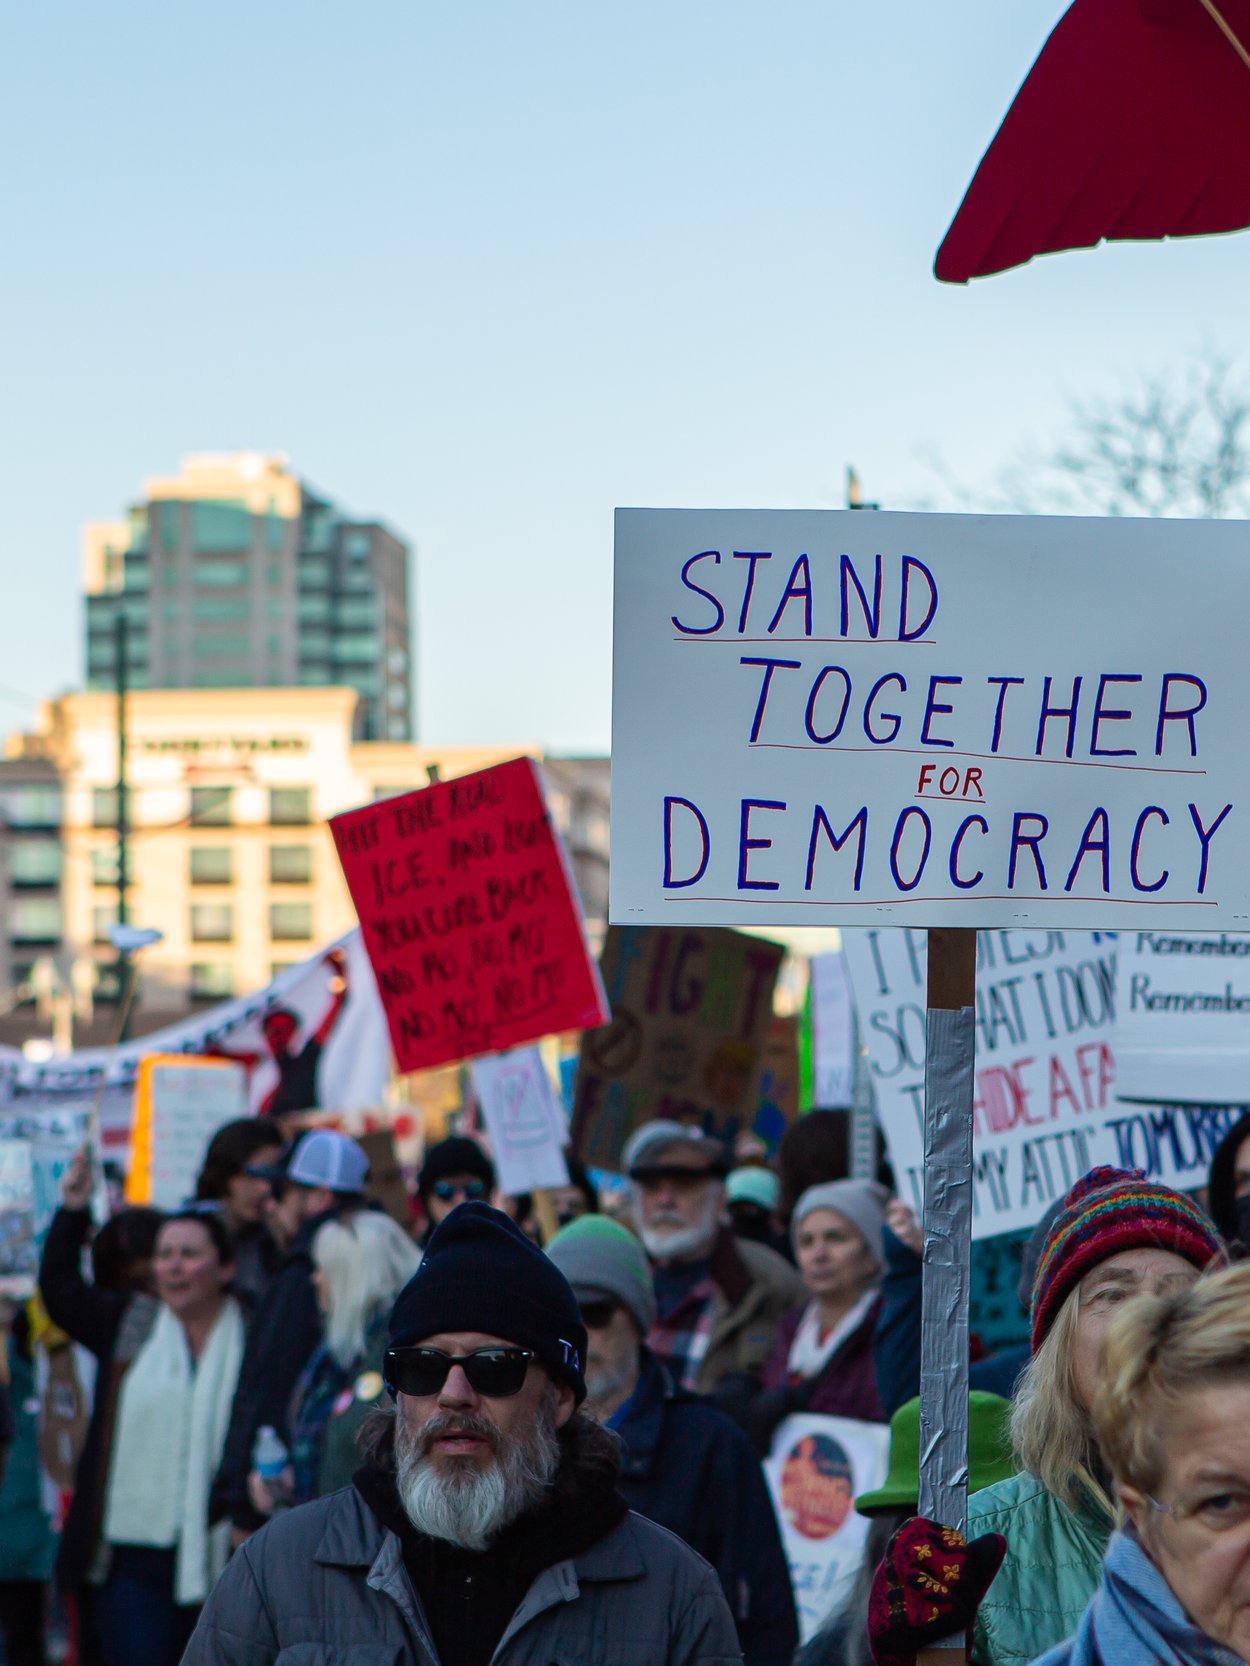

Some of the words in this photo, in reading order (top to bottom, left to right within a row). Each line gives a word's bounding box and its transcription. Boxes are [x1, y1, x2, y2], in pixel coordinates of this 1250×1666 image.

[670, 550, 939, 641] STAND
[739, 656, 1208, 760] TOGETHER
[917, 763, 984, 798] FOR
[662, 796, 1233, 894] DEMOCRACY
[611, 927, 784, 1037] FIGHT
[865, 930, 890, 996] I
[975, 976, 1027, 1055] HAT
[1033, 970, 1058, 1039] I
[1056, 953, 1117, 1034] DON
[900, 1083, 925, 1145] T
